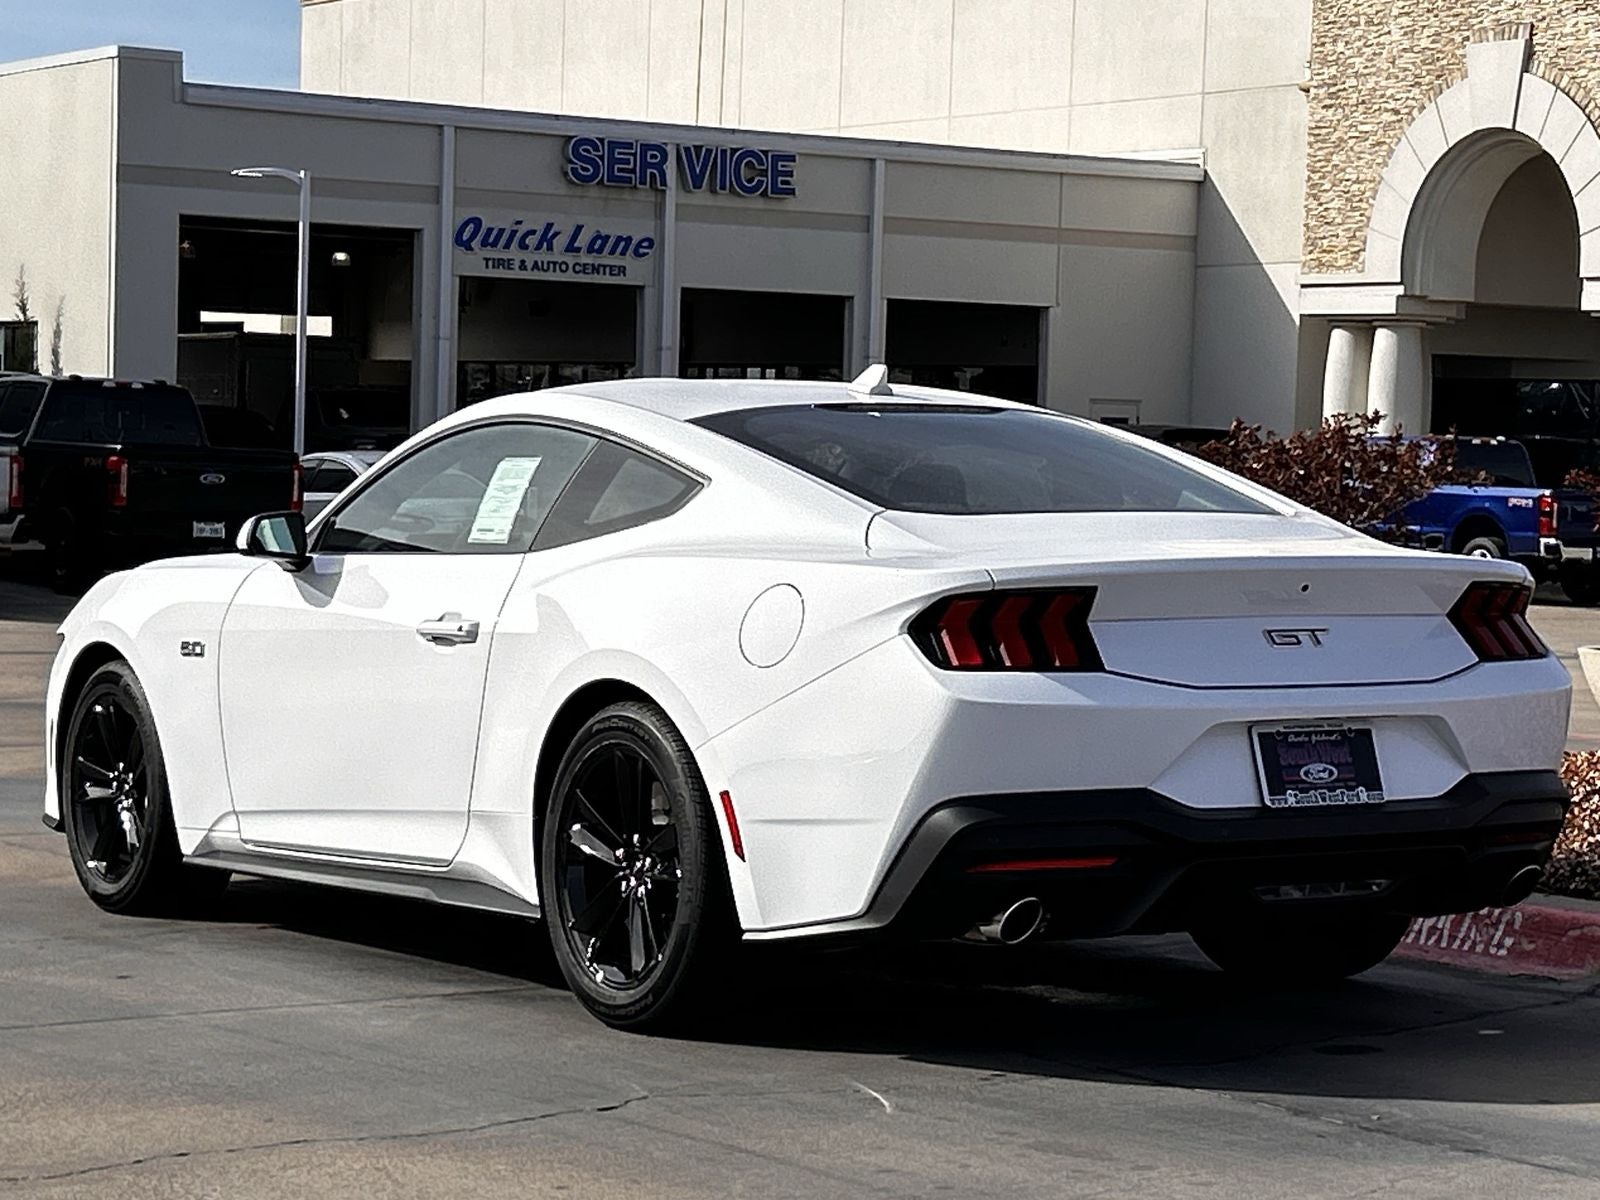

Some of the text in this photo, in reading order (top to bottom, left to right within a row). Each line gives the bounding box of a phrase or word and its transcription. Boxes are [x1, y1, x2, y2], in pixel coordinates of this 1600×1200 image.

[565, 136, 797, 198] SERVICE
[453, 216, 656, 260] Quick Lane
[483, 257, 628, 278] TIRE & AUTO CENTER
[1262, 627, 1330, 648] GT
